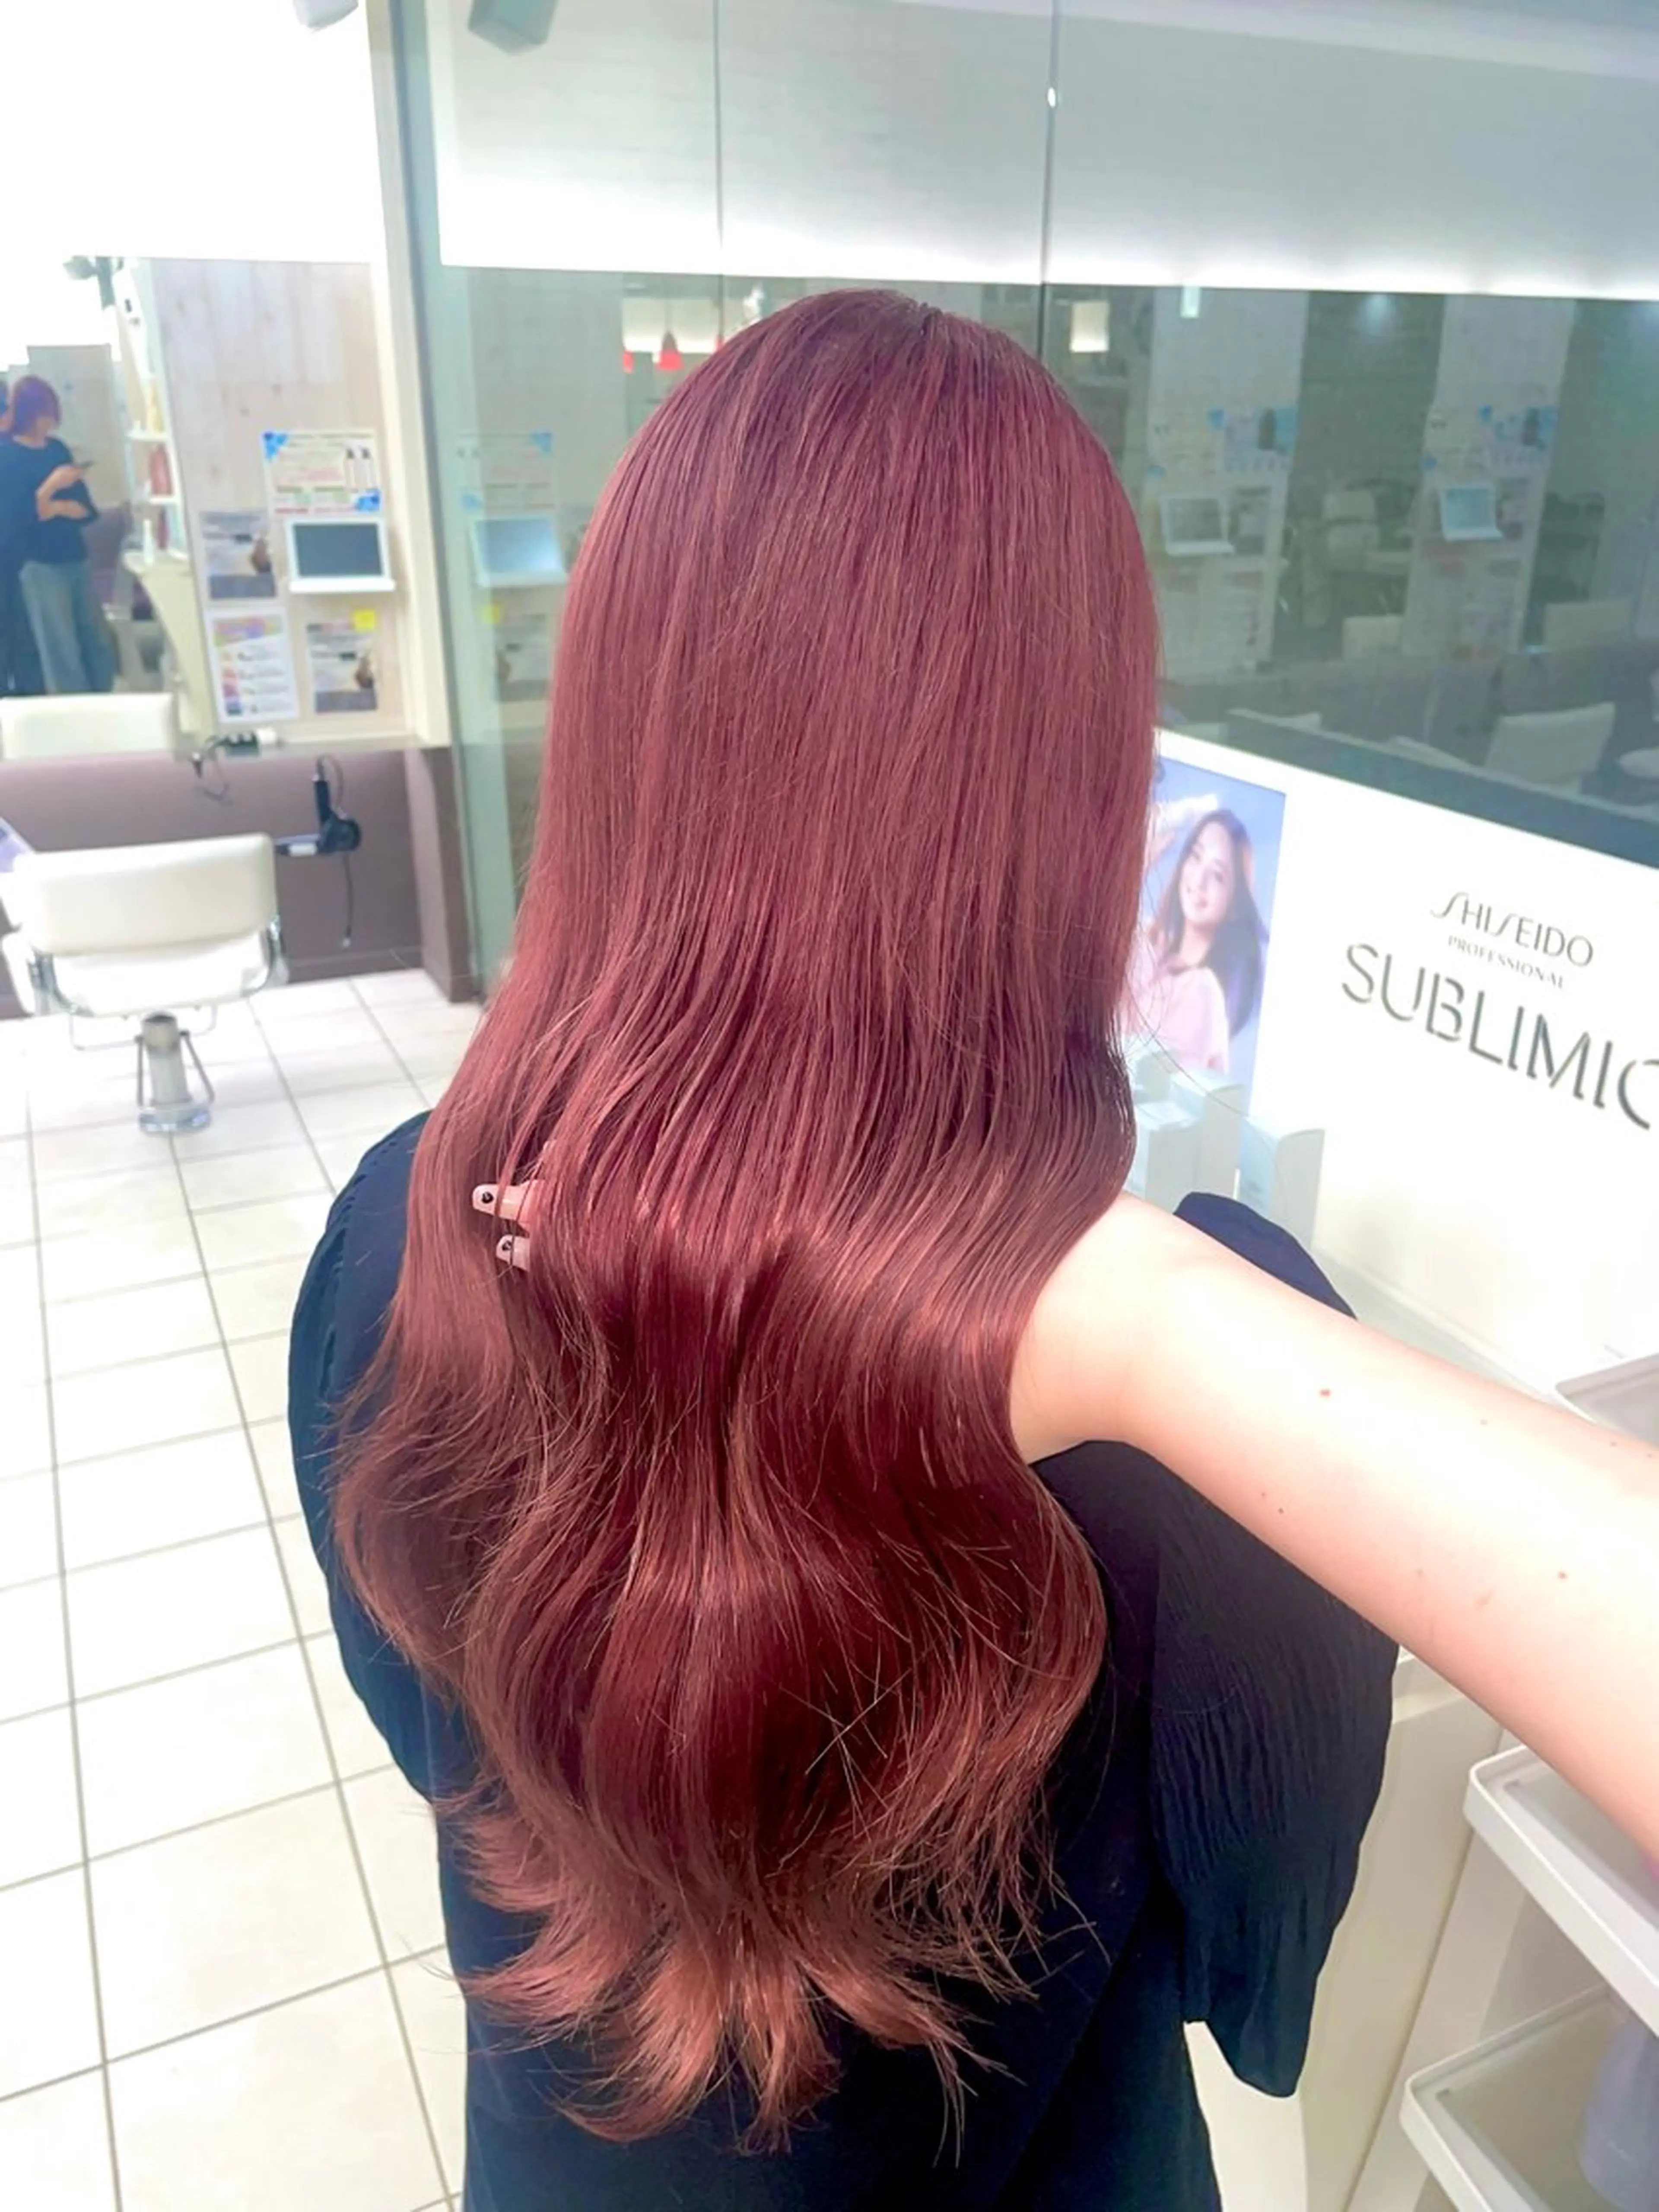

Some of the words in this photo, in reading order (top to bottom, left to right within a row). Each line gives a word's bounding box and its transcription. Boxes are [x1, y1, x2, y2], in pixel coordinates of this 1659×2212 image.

[1430, 892, 1594, 967] SHISEIDO
[1448, 935, 1564, 989] PROFESSIONAL
[1341, 944, 1659, 1131] SUBLIMIC
